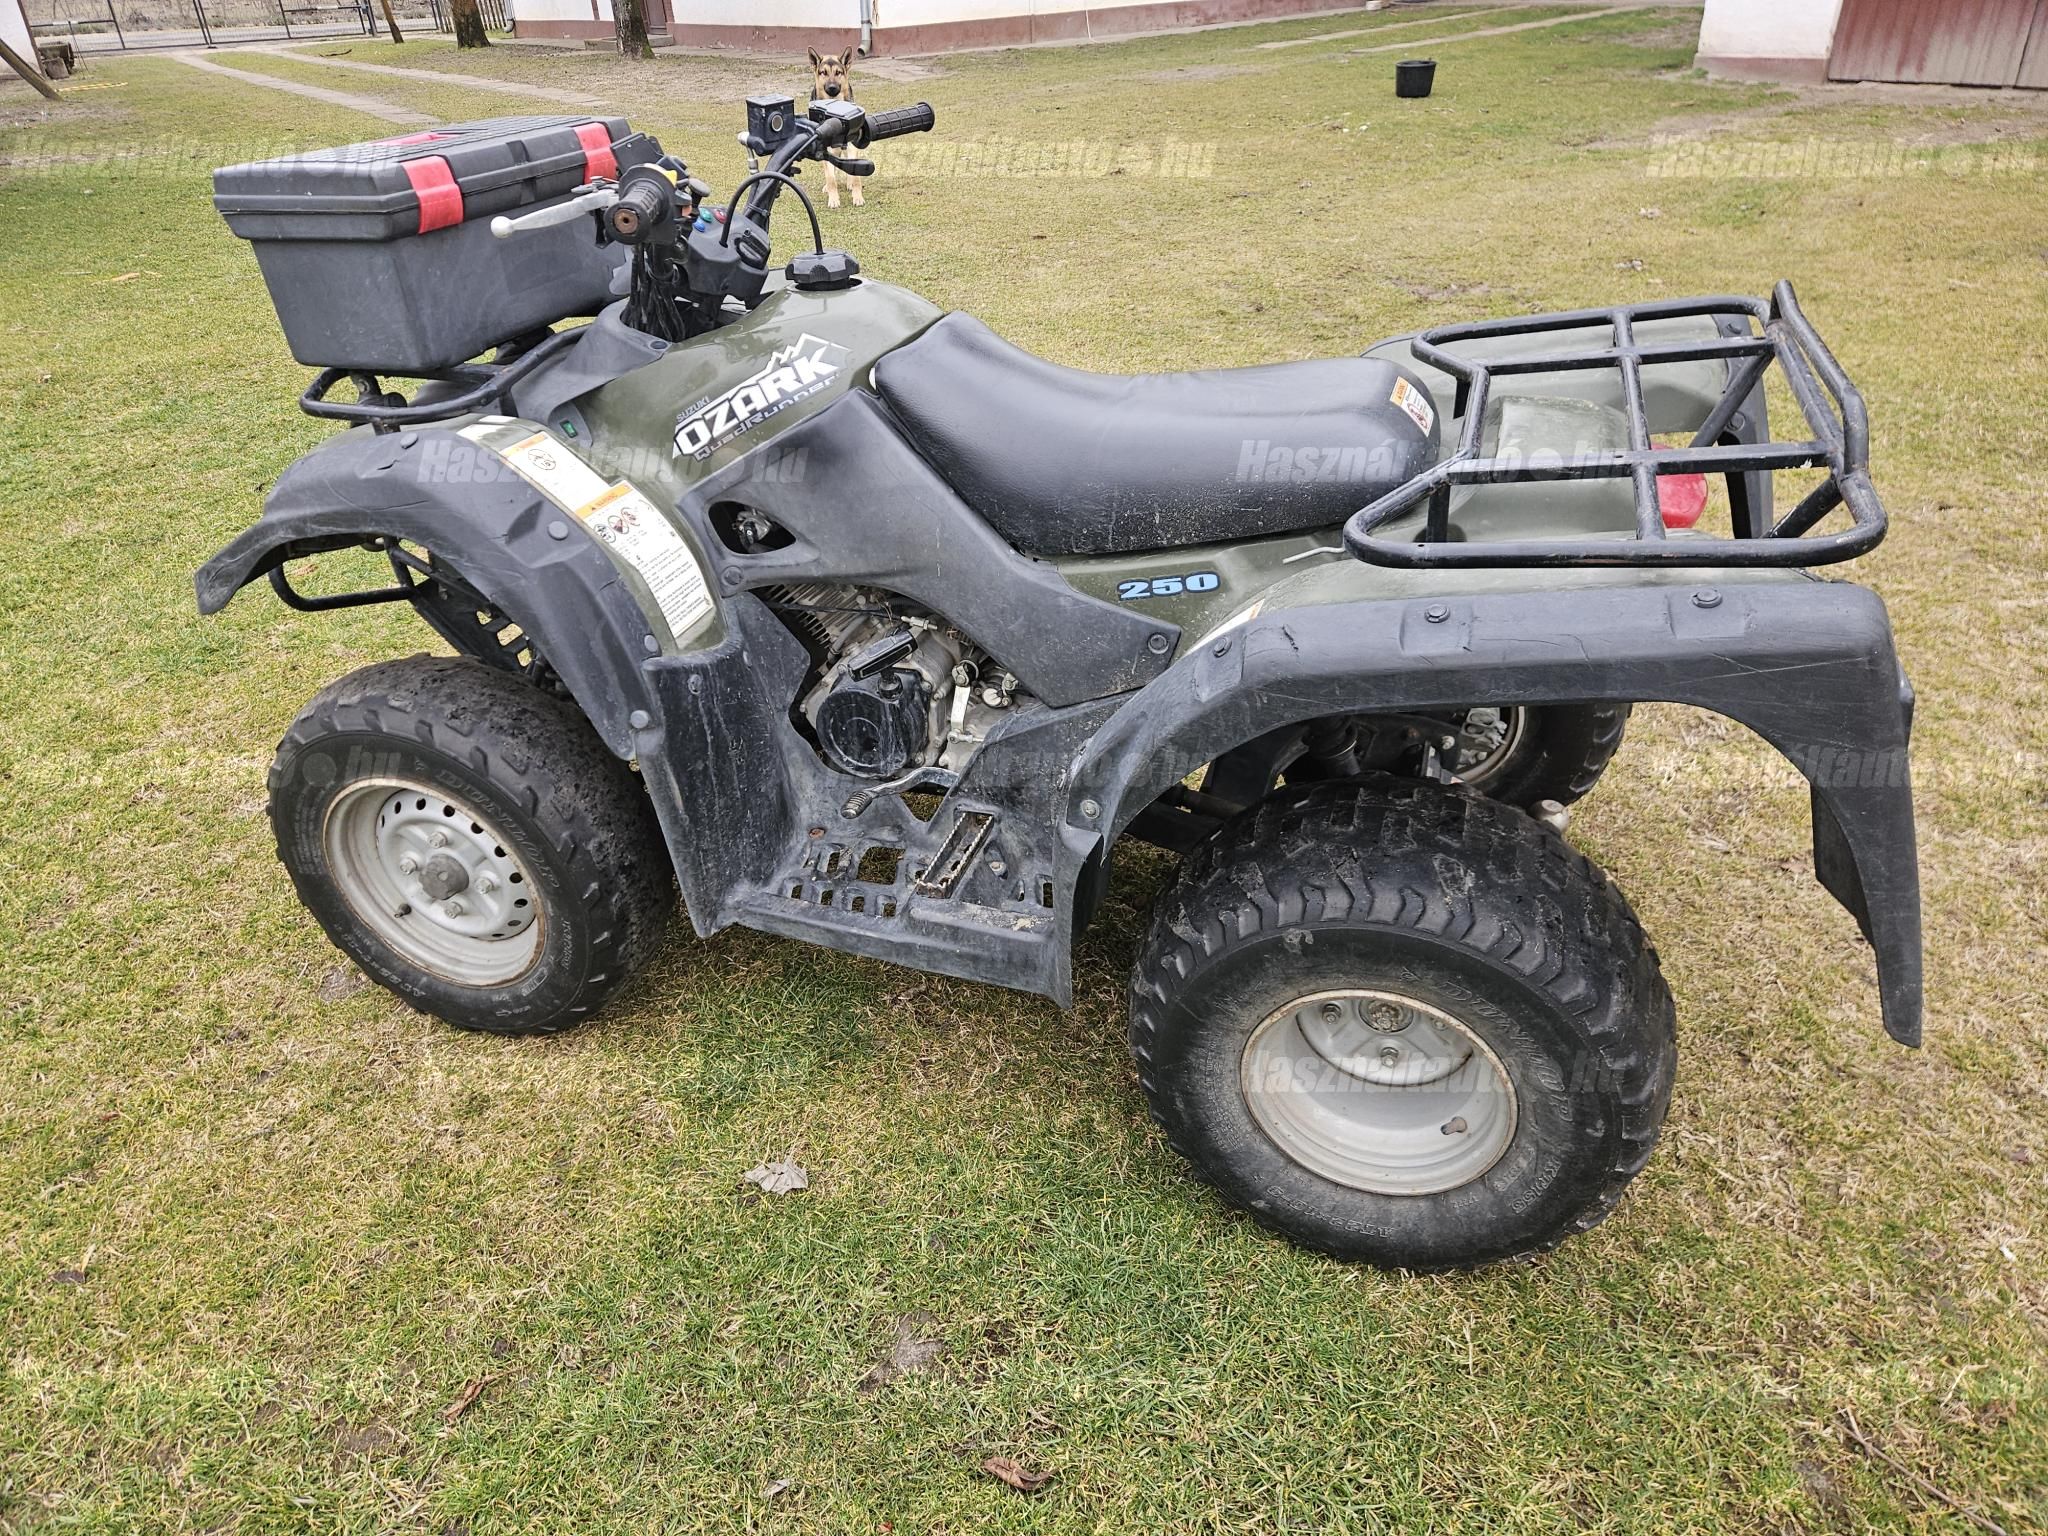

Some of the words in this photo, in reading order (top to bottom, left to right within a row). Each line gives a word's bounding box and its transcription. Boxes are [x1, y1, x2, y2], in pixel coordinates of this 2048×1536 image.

[674, 346, 839, 455] OZARK
[676, 396, 711, 422] SUZUKI
[1117, 570, 1220, 600] 250
[1437, 980, 1574, 1122] DUNLOP
